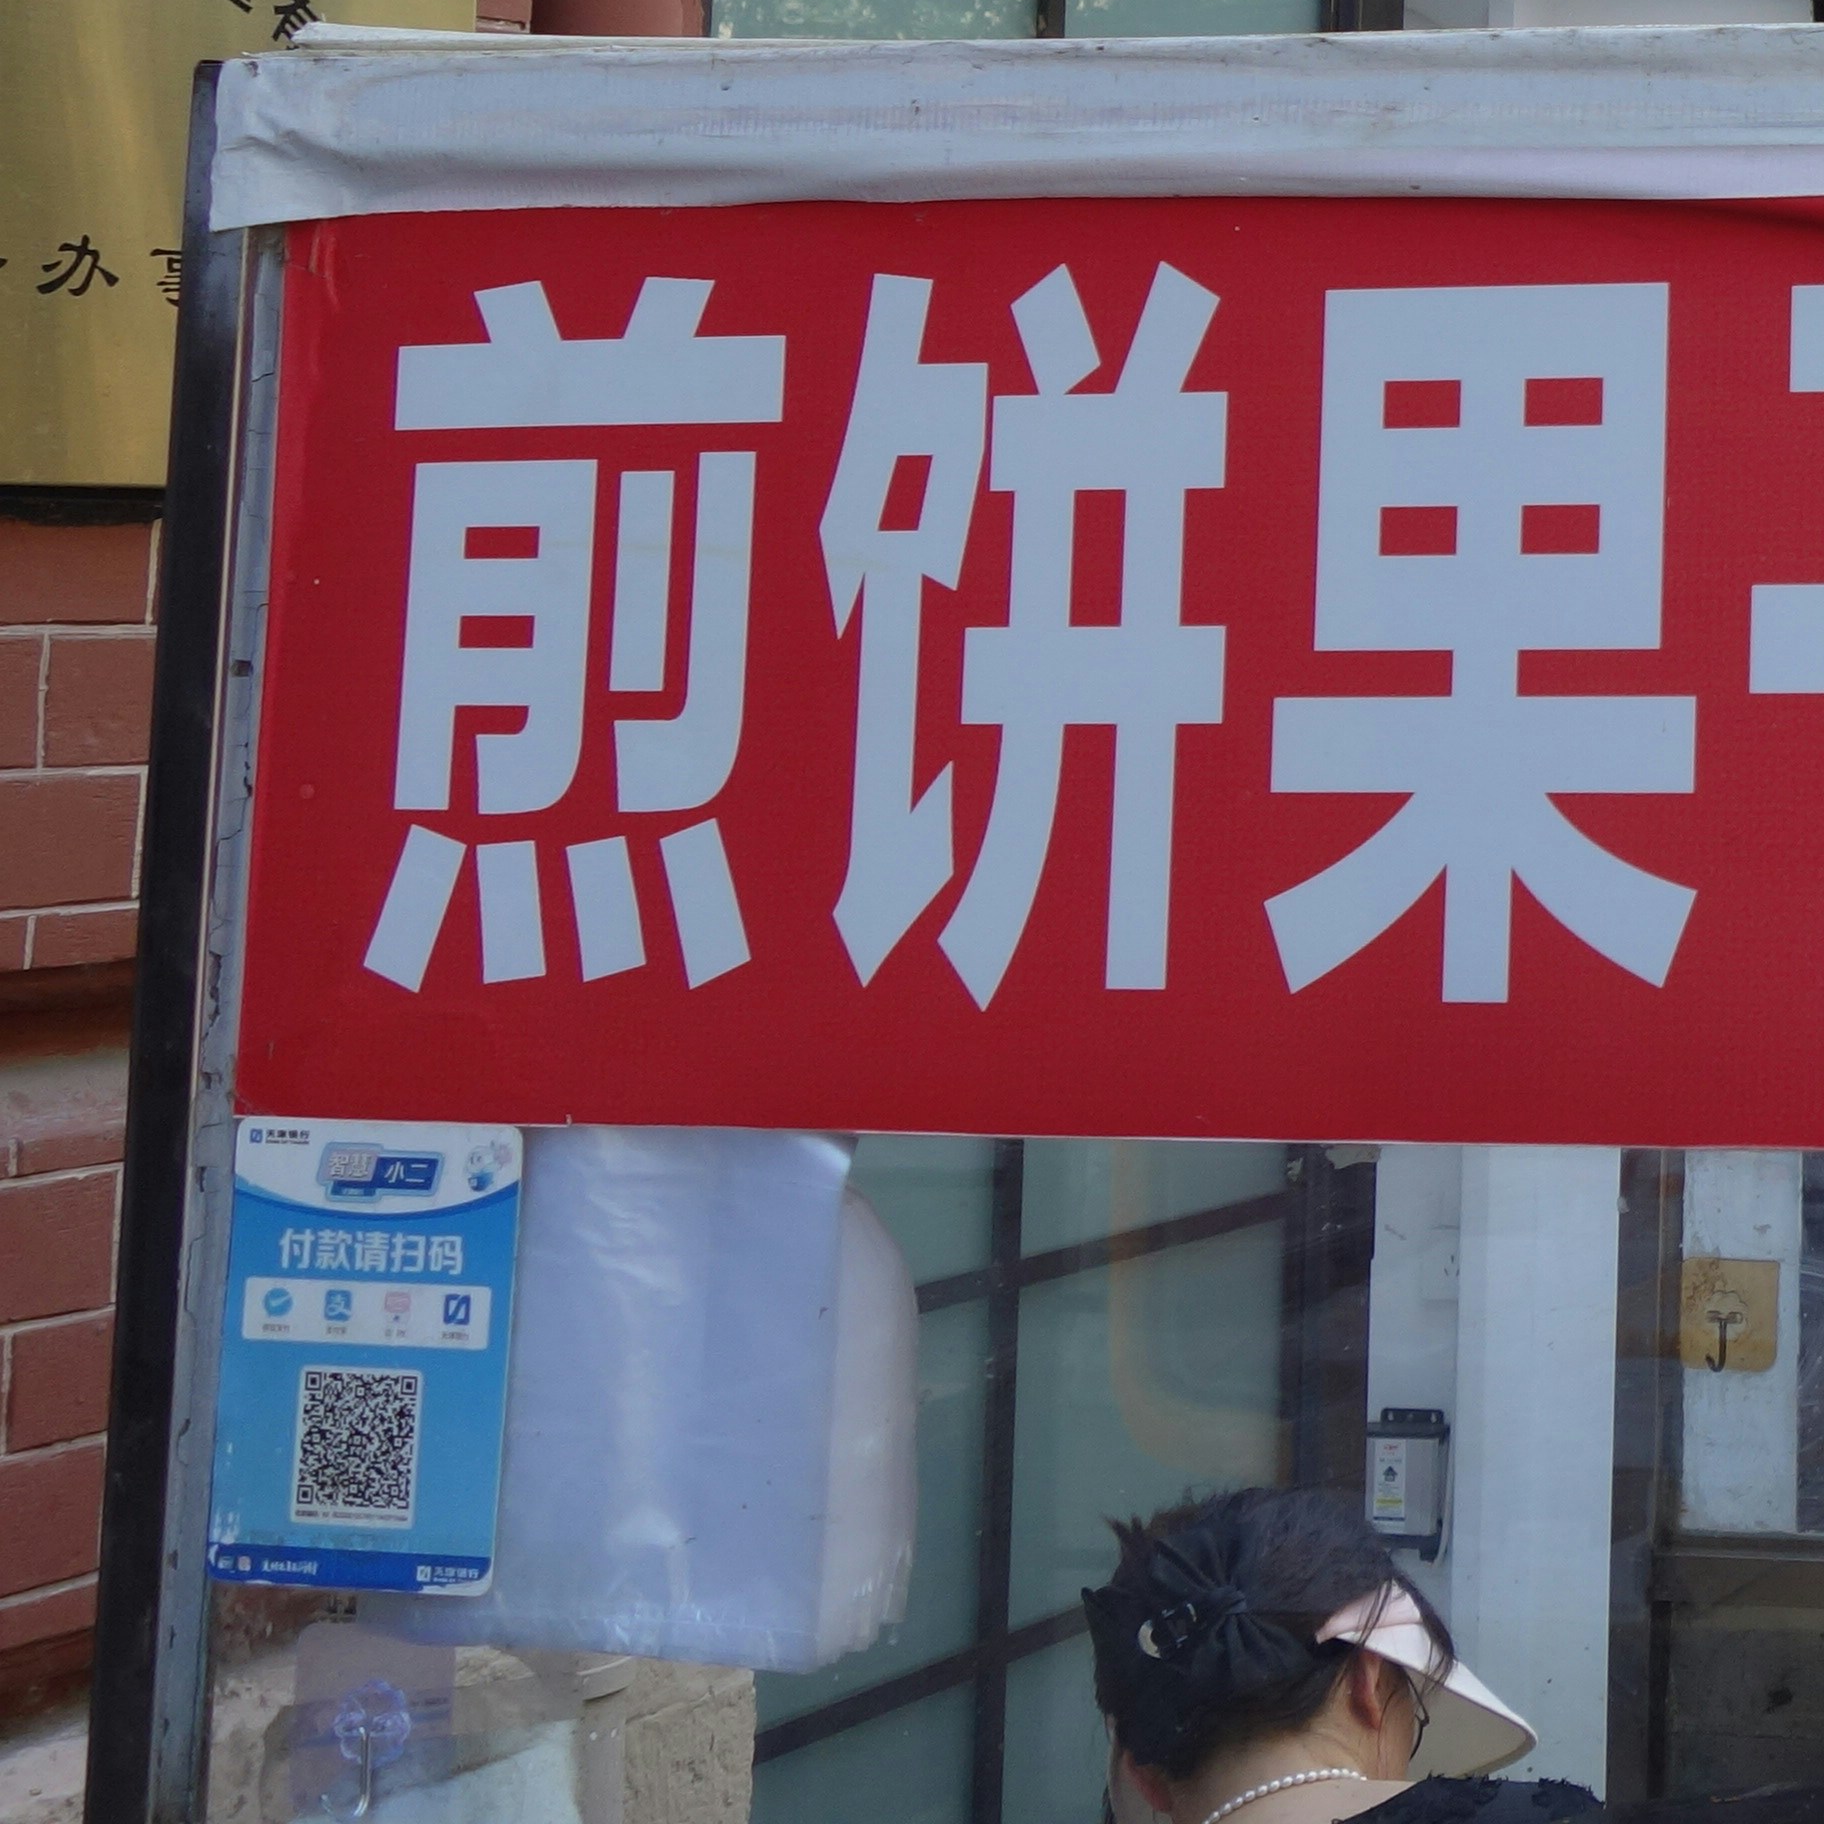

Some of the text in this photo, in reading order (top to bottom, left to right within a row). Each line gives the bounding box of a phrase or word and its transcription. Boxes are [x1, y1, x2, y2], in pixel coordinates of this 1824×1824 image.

[279, 1228, 463, 1275] 付款请扫码
